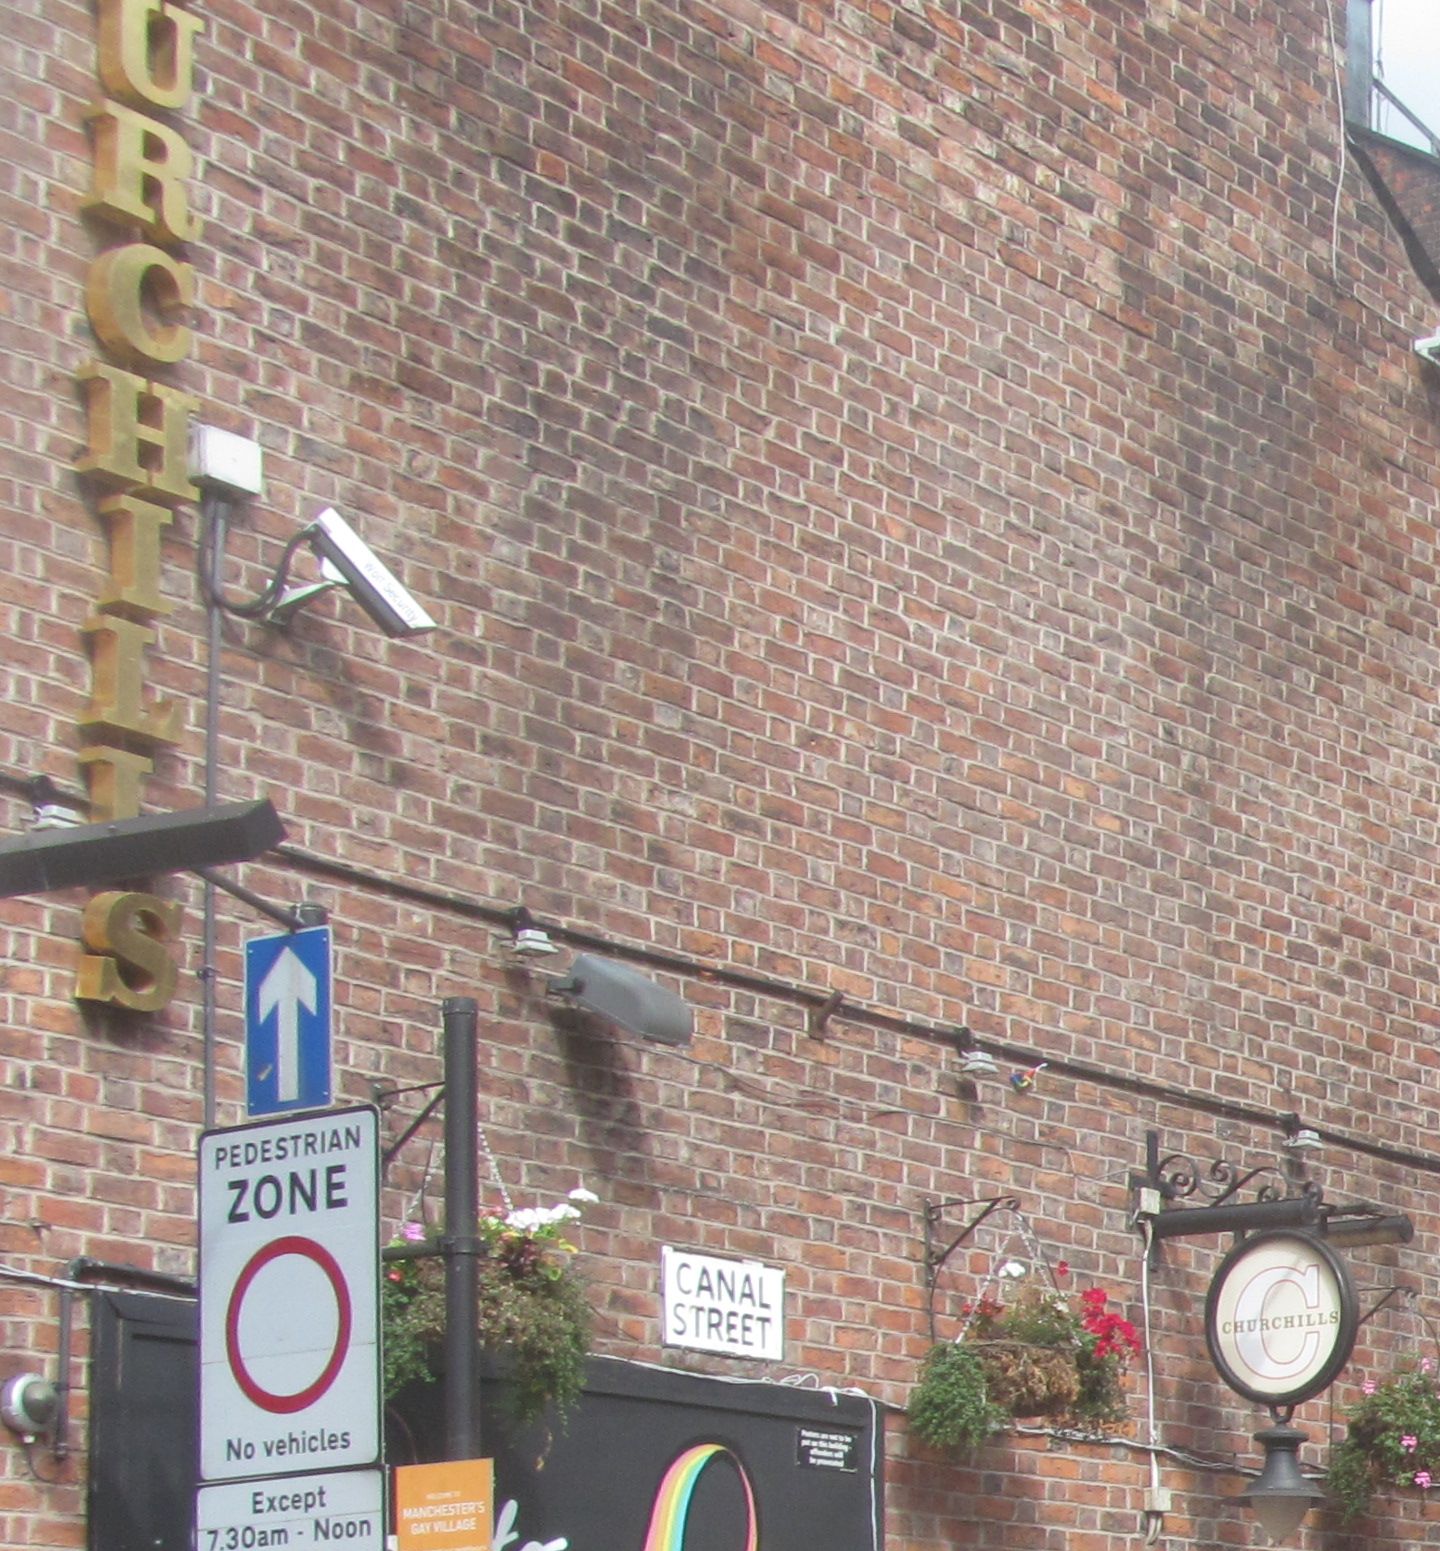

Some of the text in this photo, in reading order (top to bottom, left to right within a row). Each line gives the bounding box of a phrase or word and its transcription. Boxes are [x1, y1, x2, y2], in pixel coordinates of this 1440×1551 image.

[215, 1125, 361, 1170] PEDESTRIAN
[227, 1165, 349, 1224] ZONE
[676, 1262, 772, 1310] CANAL
[672, 1302, 772, 1350] STREET
[1222, 1311, 1340, 1335] CHURCHILLS
[226, 1428, 351, 1462] No vehicles
[251, 1486, 327, 1515] Except
[403, 1501, 486, 1519] MANCHESTER'S
[207, 1526, 289, 1551] 7.30am
[314, 1519, 372, 1542] Noon
[410, 1518, 477, 1536] GAY VILLAGE
